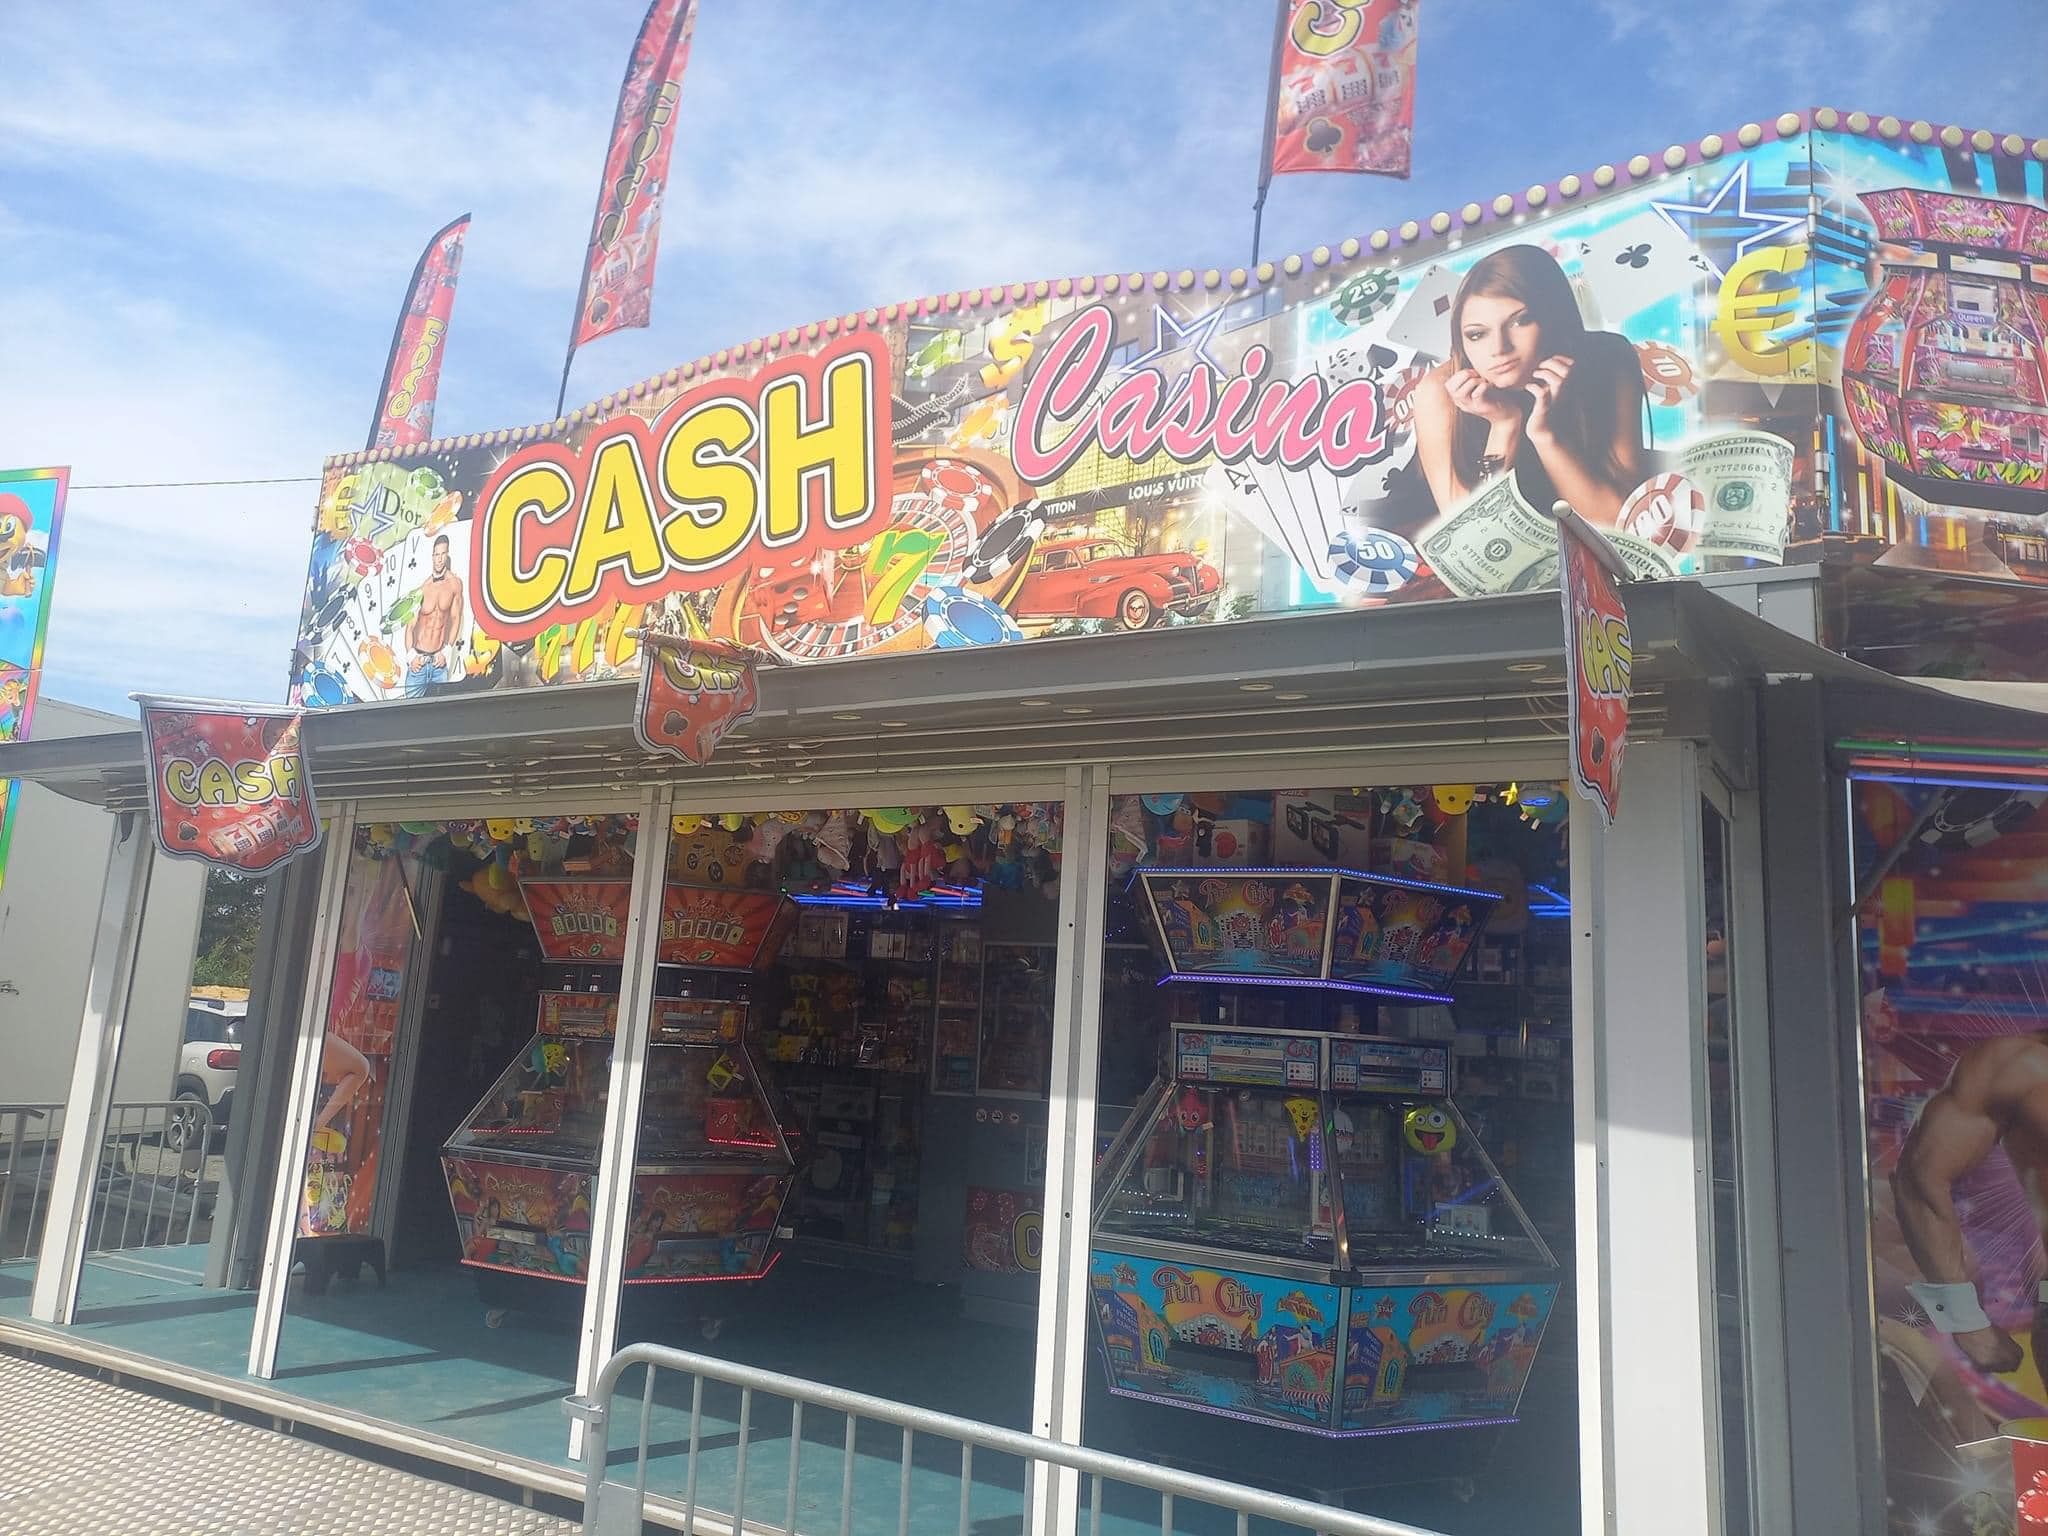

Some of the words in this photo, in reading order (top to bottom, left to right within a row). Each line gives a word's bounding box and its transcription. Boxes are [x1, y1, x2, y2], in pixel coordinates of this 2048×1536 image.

[1348, 277, 1379, 304] 25
[1011, 304, 1390, 484] Casino
[382, 486, 422, 526] Dior
[482, 350, 875, 624] CASH
[384, 554, 397, 574] 10
[1358, 540, 1396, 561] 50
[364, 583, 373, 599] 9
[863, 528, 948, 625] 7
[165, 753, 303, 806] CASH
[1151, 1265, 1202, 1312] Fun
[1214, 1276, 1264, 1322] City
[1456, 1291, 1497, 1330] City
